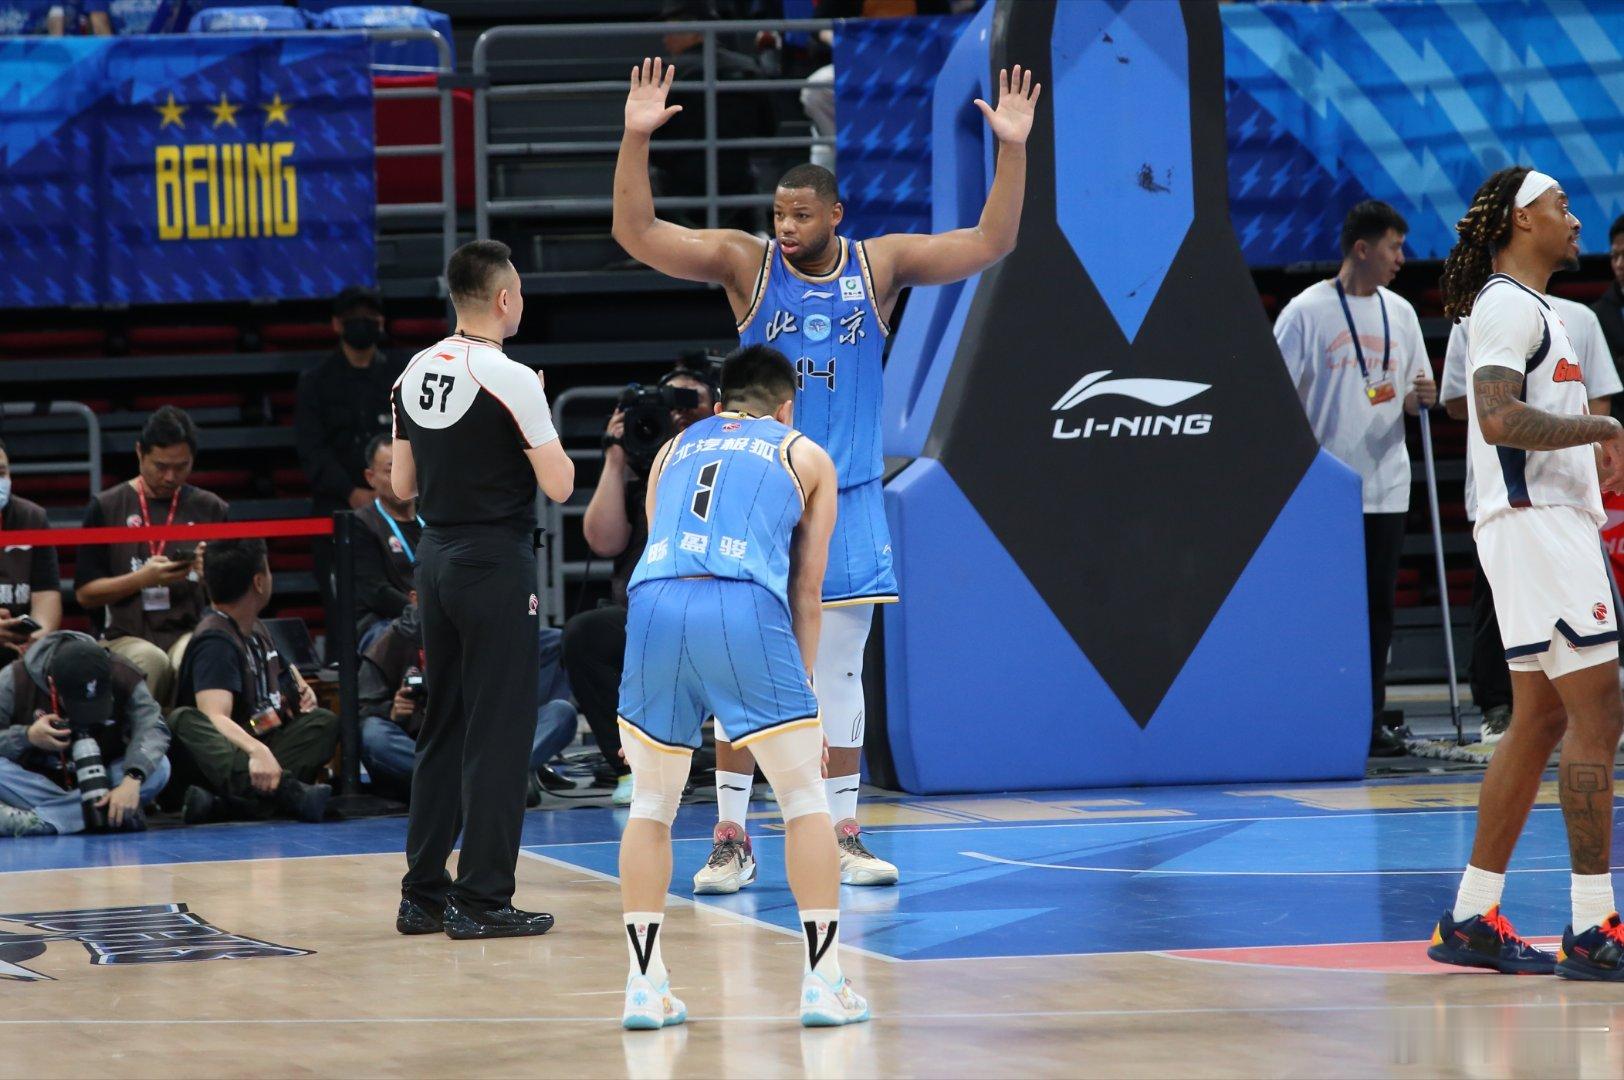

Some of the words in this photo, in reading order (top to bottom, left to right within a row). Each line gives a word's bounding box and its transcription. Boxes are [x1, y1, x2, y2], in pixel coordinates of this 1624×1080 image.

[155, 141, 298, 240] BEIJING
[419, 372, 456, 413] 57
[795, 356, 836, 393] 14
[1052, 413, 1213, 440] LI-NING
[690, 458, 723, 524] 1
